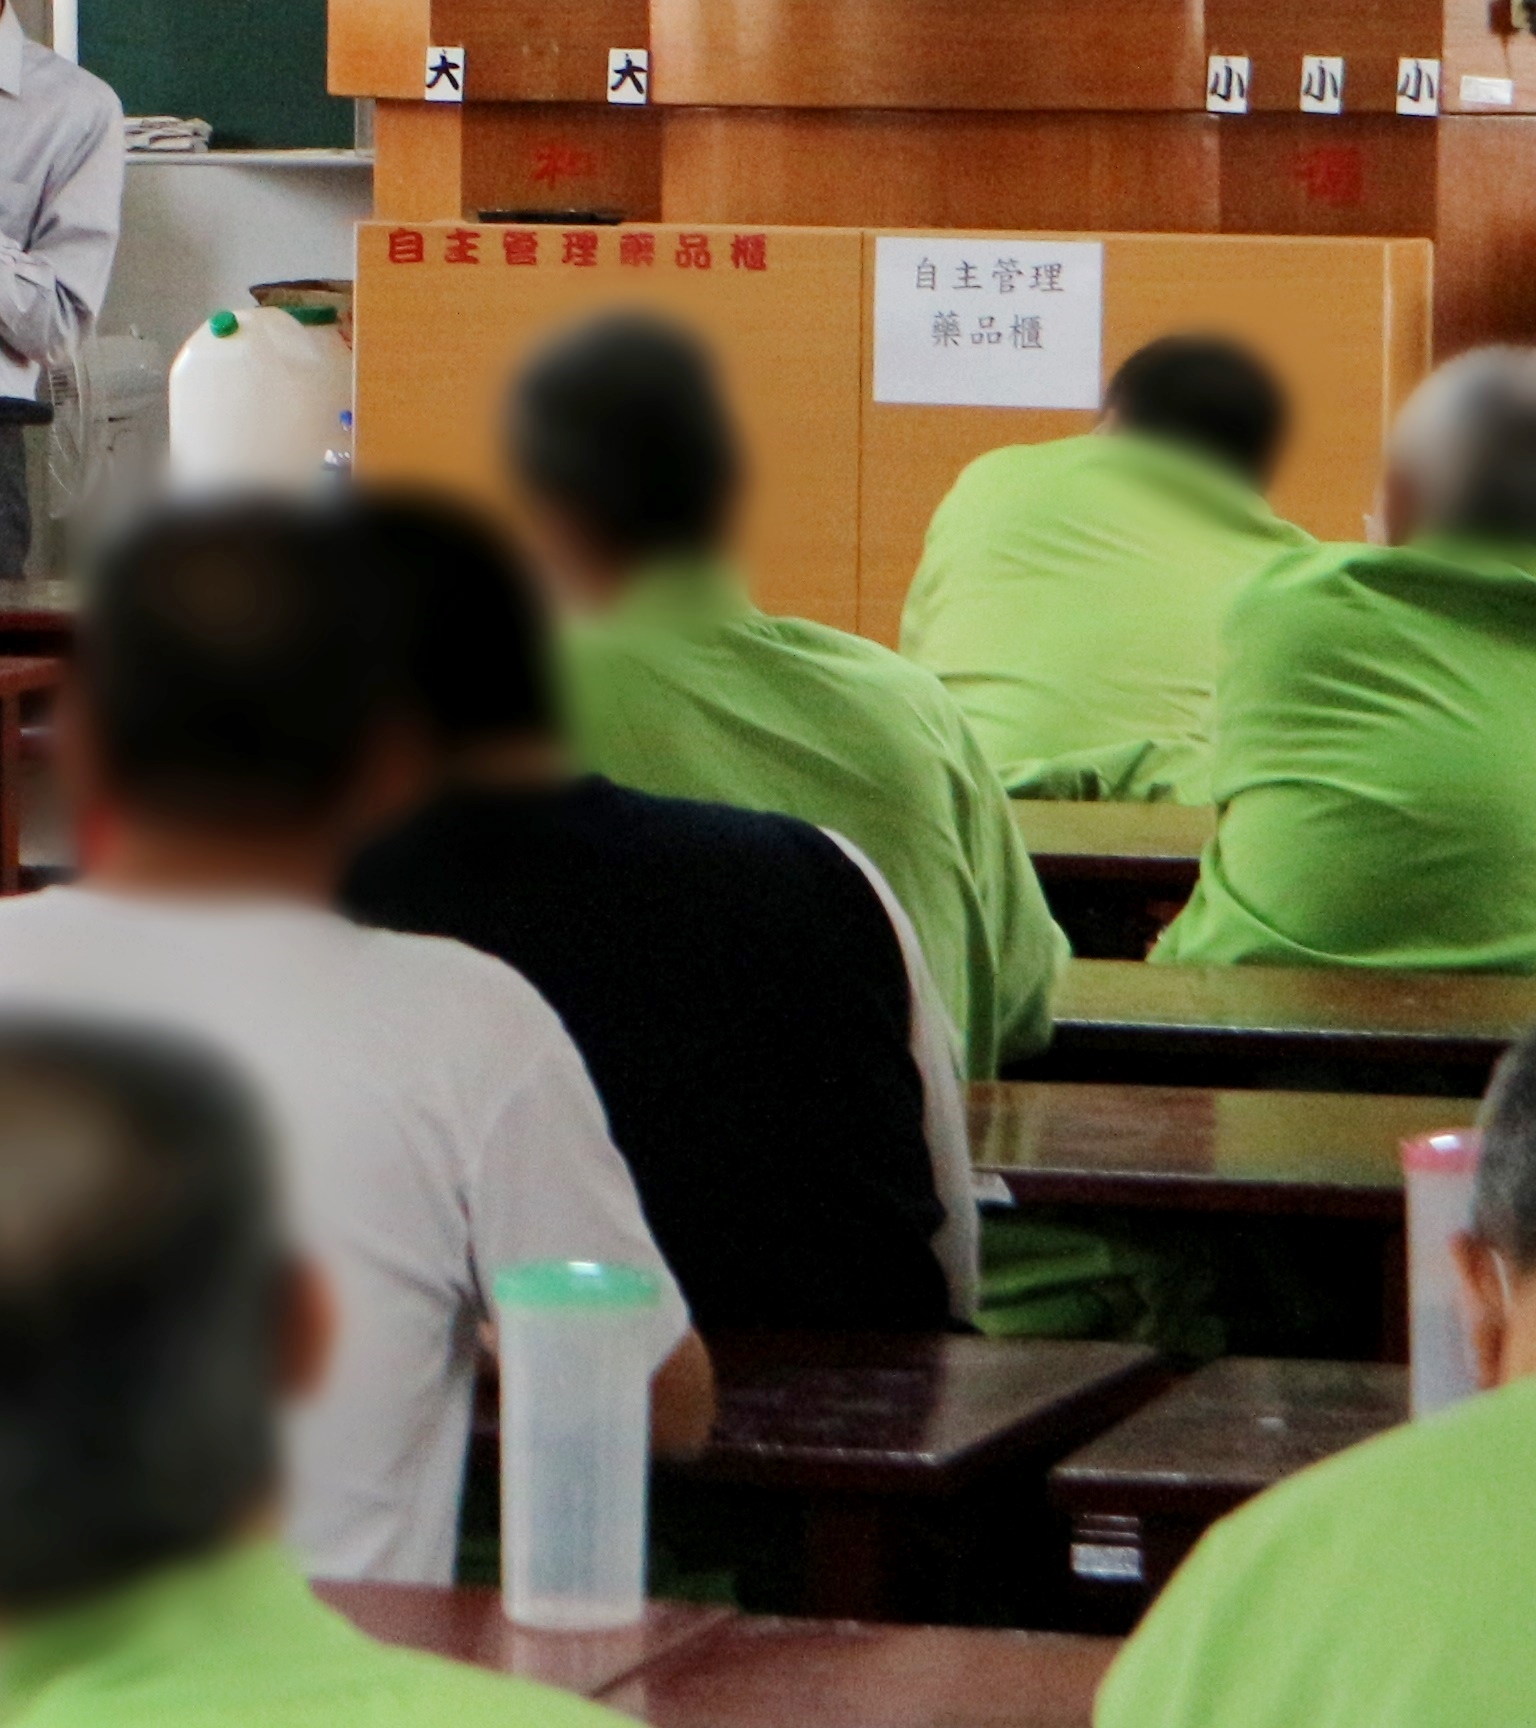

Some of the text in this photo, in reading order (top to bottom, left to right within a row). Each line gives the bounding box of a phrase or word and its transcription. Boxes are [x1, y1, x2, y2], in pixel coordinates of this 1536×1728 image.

[427, 52, 461, 90] 大
[610, 54, 648, 94] 大
[1210, 64, 1245, 102] 小
[1302, 63, 1339, 102] 小
[1398, 63, 1435, 103] 小
[915, 256, 1065, 294] 自主管理
[932, 310, 1044, 349] 藥品櫃
